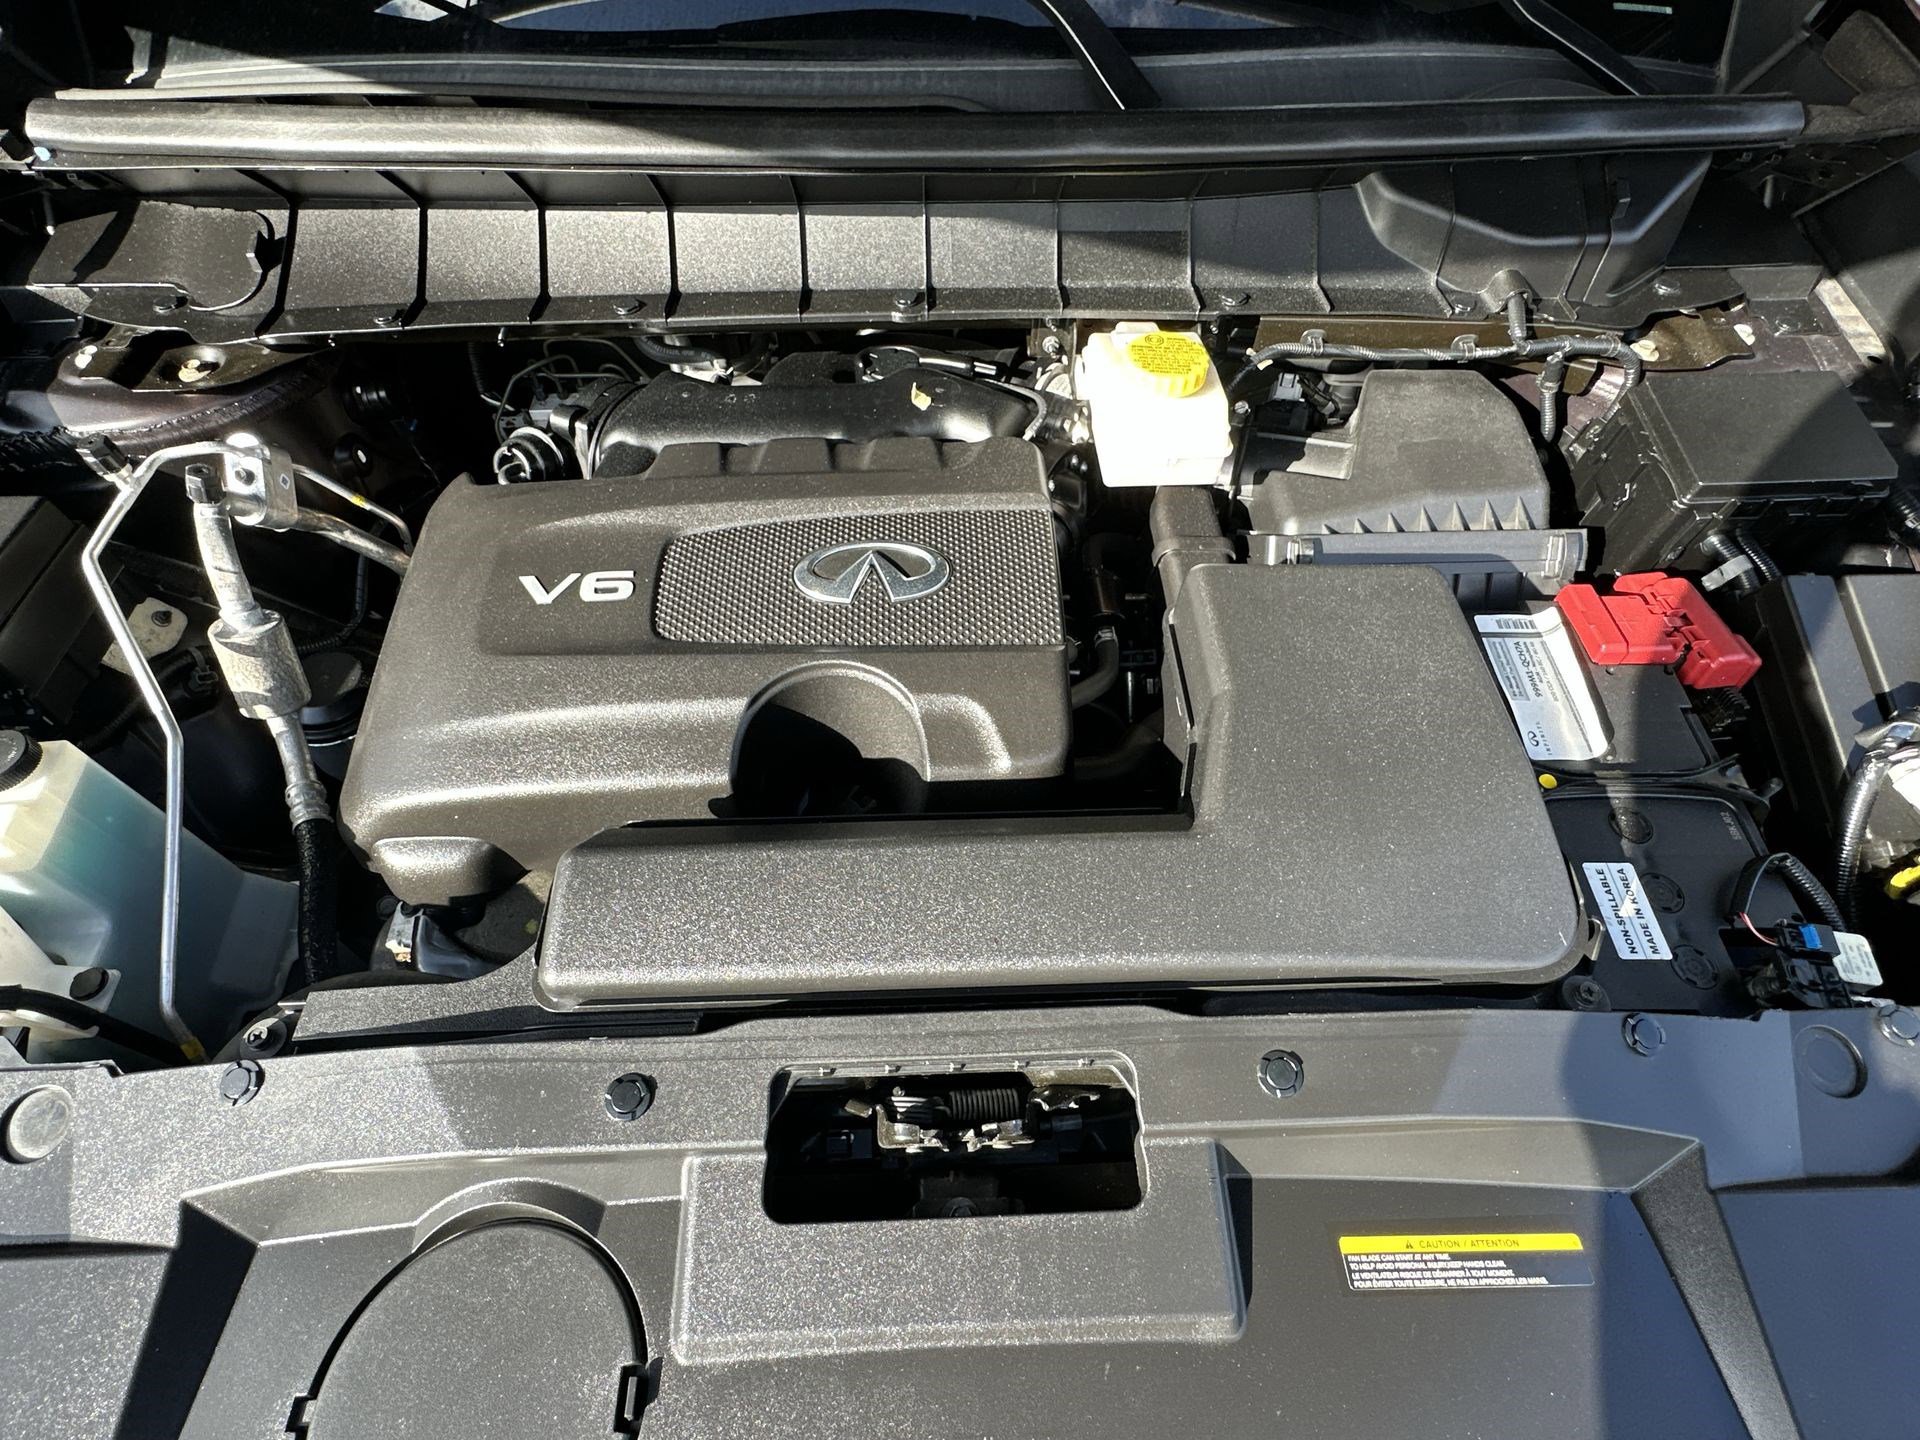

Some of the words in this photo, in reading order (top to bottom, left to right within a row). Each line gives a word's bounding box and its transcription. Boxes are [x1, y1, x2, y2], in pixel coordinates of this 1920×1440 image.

[518, 570, 635, 605] V6
[1617, 867, 1638, 905] KOREA
[1595, 868, 1638, 955] NON-SPILLABLE
[1634, 907, 1645, 919] IN
[1640, 922, 1661, 955] MADE
[1419, 1239, 1461, 1249] CAUTION
[1470, 1238, 1520, 1248] ATTENTION
[1347, 1254, 1360, 1262] FAN
[1349, 1262, 1359, 1270] TO
[1359, 1262, 1376, 1270] HELP
[1394, 1261, 1427, 1270] PERSONAL
[1353, 1280, 1373, 1288] POUR
